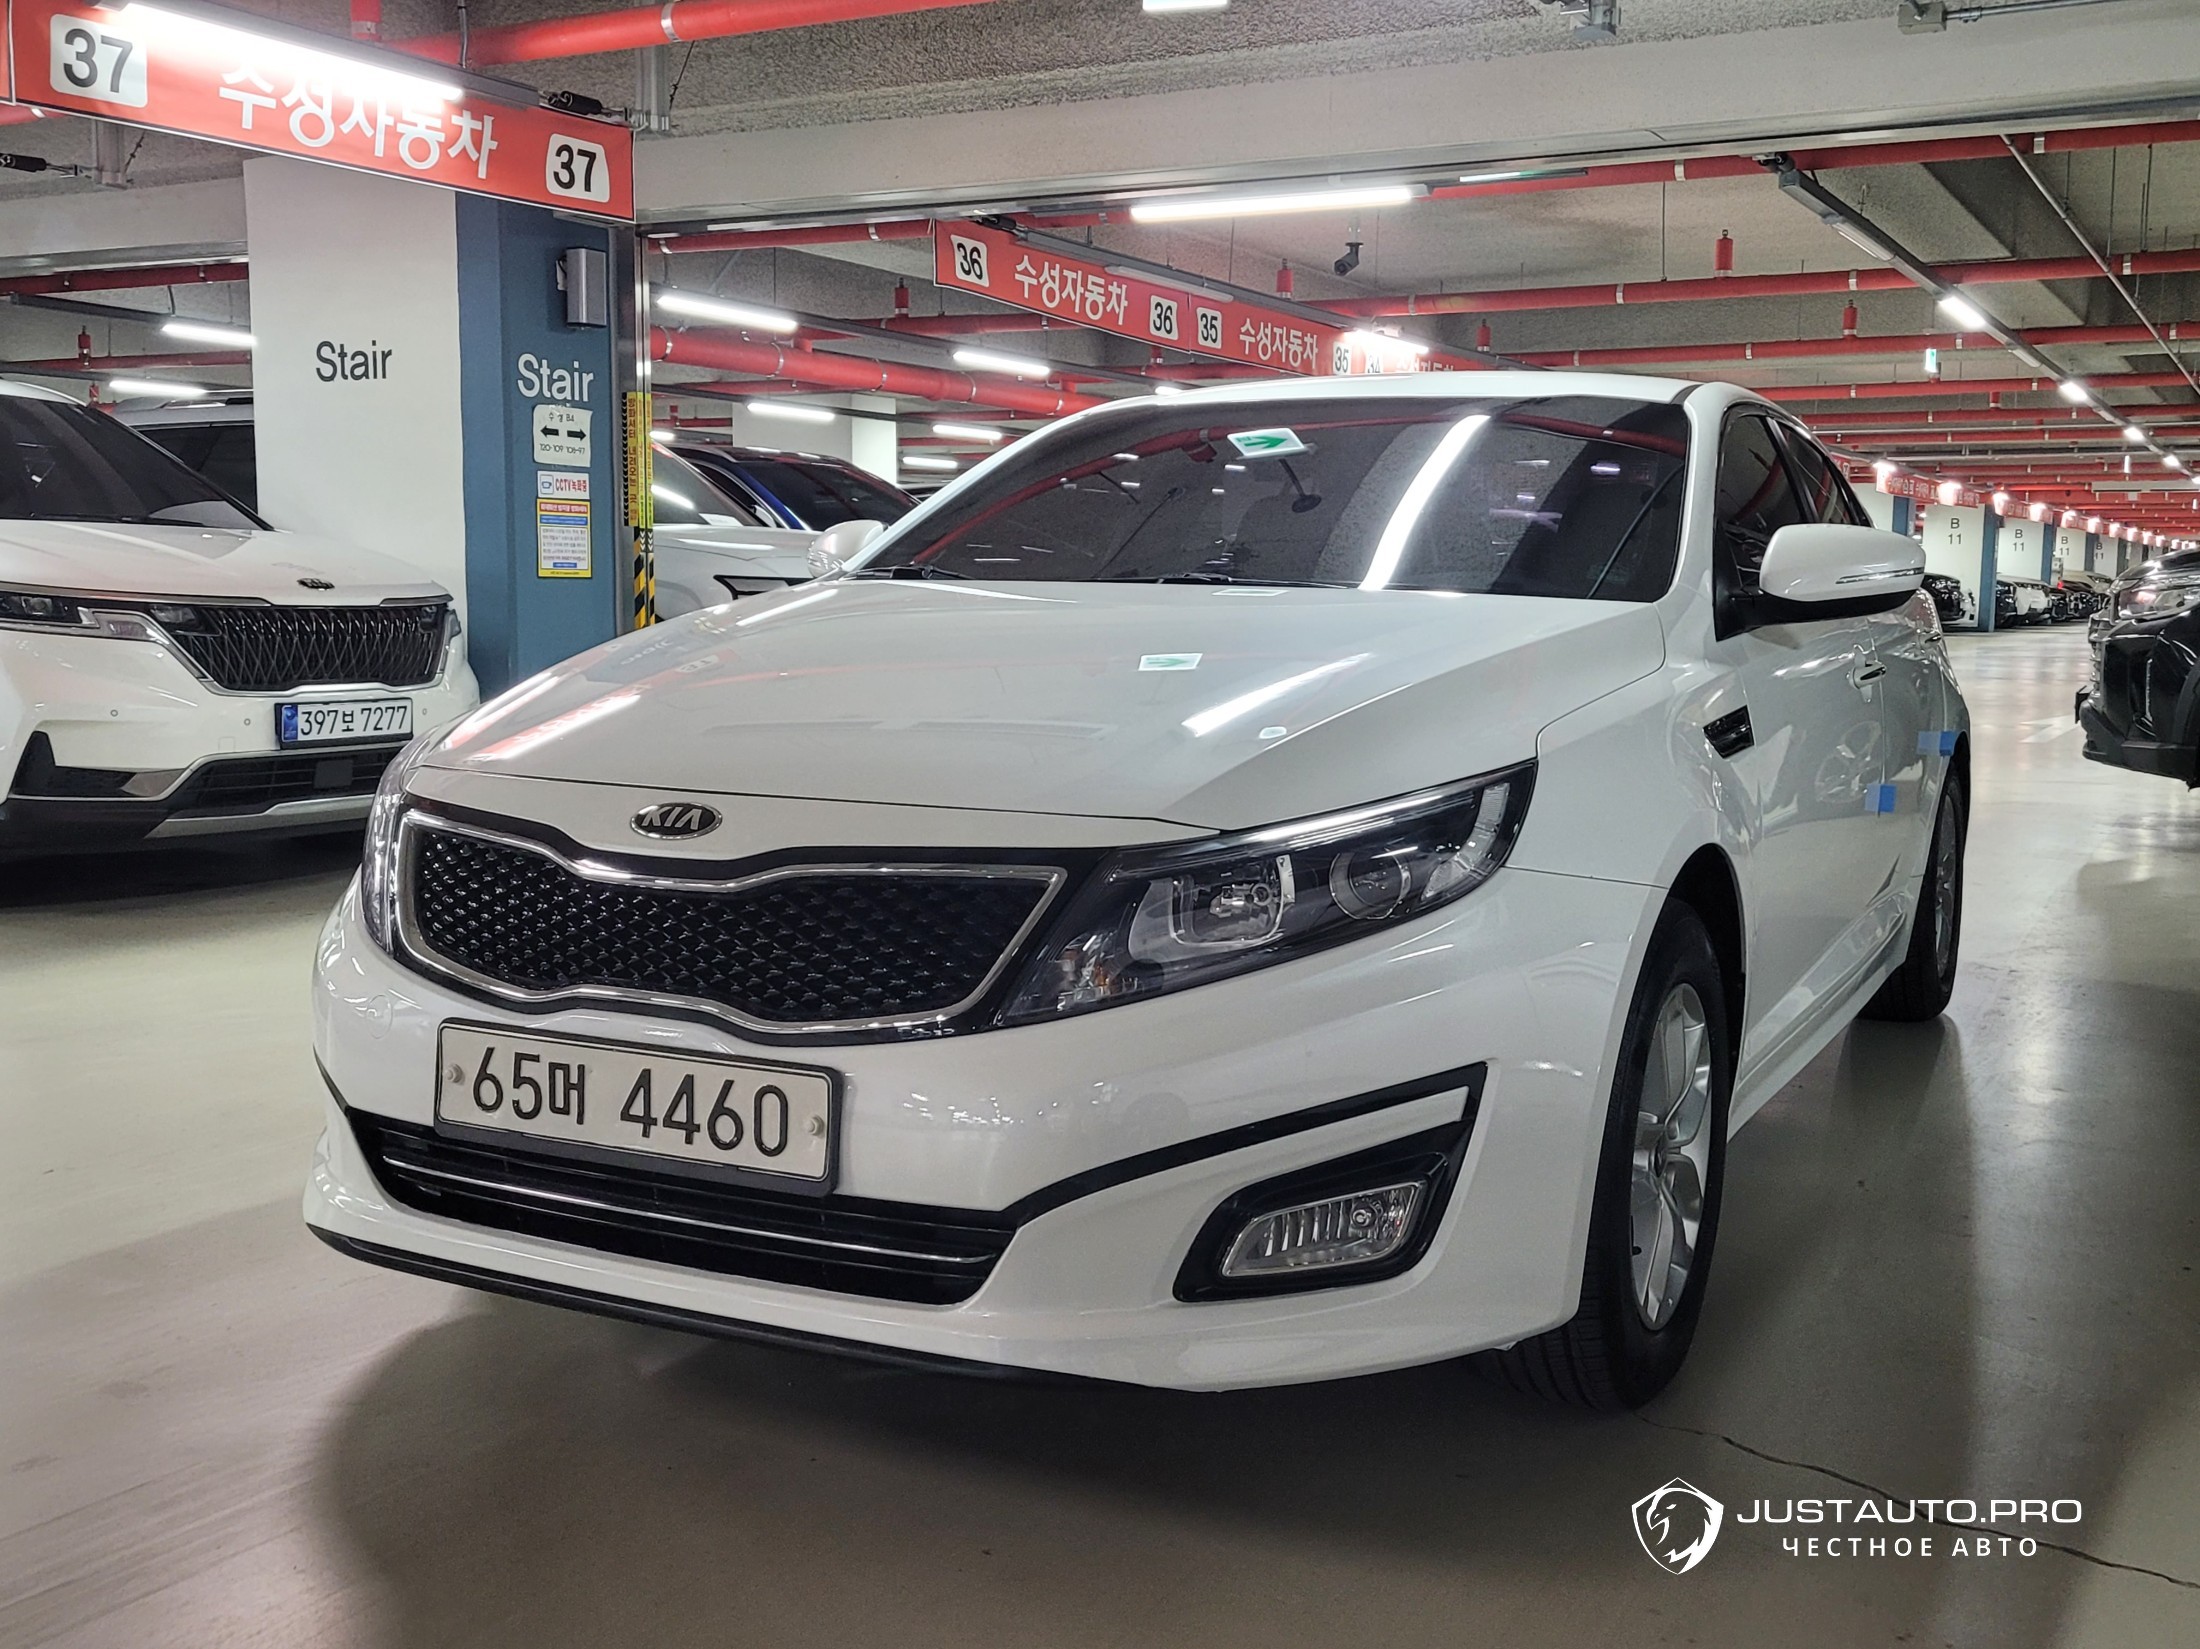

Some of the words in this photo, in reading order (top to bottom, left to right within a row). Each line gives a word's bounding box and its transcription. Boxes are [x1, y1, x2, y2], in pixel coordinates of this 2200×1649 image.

[62, 27, 134, 94] 37
[218, 66, 500, 180] 수성자동차
[552, 143, 598, 193] 37
[956, 241, 984, 281] 36
[1014, 254, 1129, 326] 수성자동차
[1152, 301, 1174, 336] 36
[315, 340, 393, 382] Stair
[1200, 312, 1218, 344] 35
[1239, 317, 1319, 369] 수성자동차
[1334, 345, 1349, 374] 35
[517, 353, 595, 402] Stair
[1947, 533, 1962, 545] 11
[1950, 517, 1960, 529] B
[2014, 528, 2023, 539] B
[2012, 542, 2025, 552] 11
[300, 709, 355, 736] 397보
[360, 705, 408, 732] 7277
[641, 806, 703, 831] KIA
[472, 1046, 586, 1126] 65머
[619, 1067, 789, 1158] 4460
